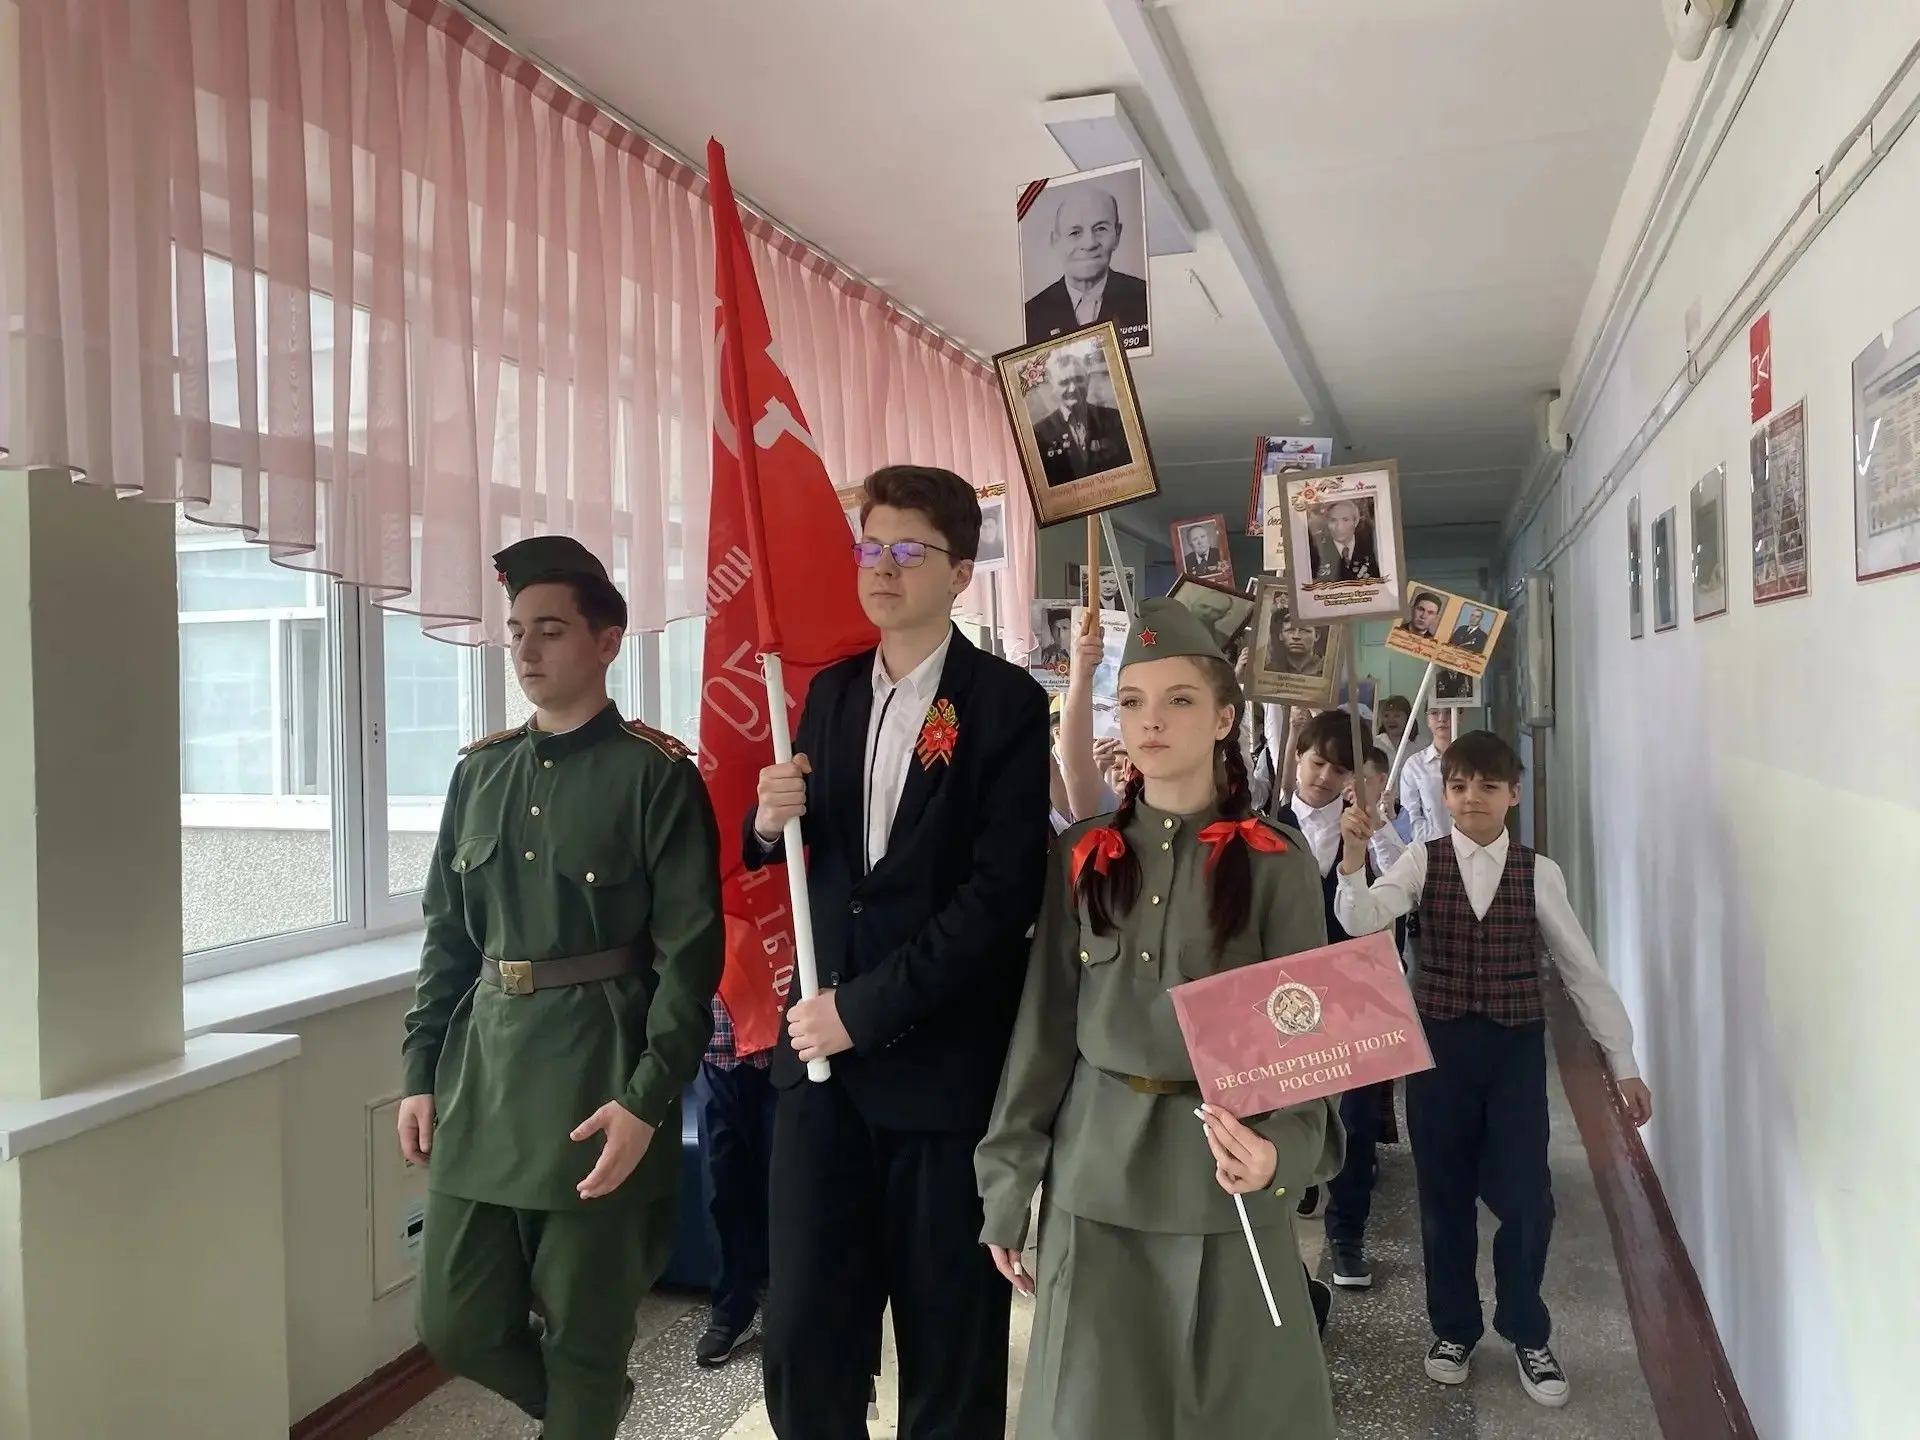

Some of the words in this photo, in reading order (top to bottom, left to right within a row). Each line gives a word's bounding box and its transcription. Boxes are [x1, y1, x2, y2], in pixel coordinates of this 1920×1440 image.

[1119, 323, 1149, 334] иевич
[1123, 336, 1140, 348] 990
[1215, 1041, 1352, 1092] БЕССМЕРТНЫЙ
[1354, 1029, 1407, 1055] ПОЛК
[1279, 1062, 1353, 1093] РОССИИ
